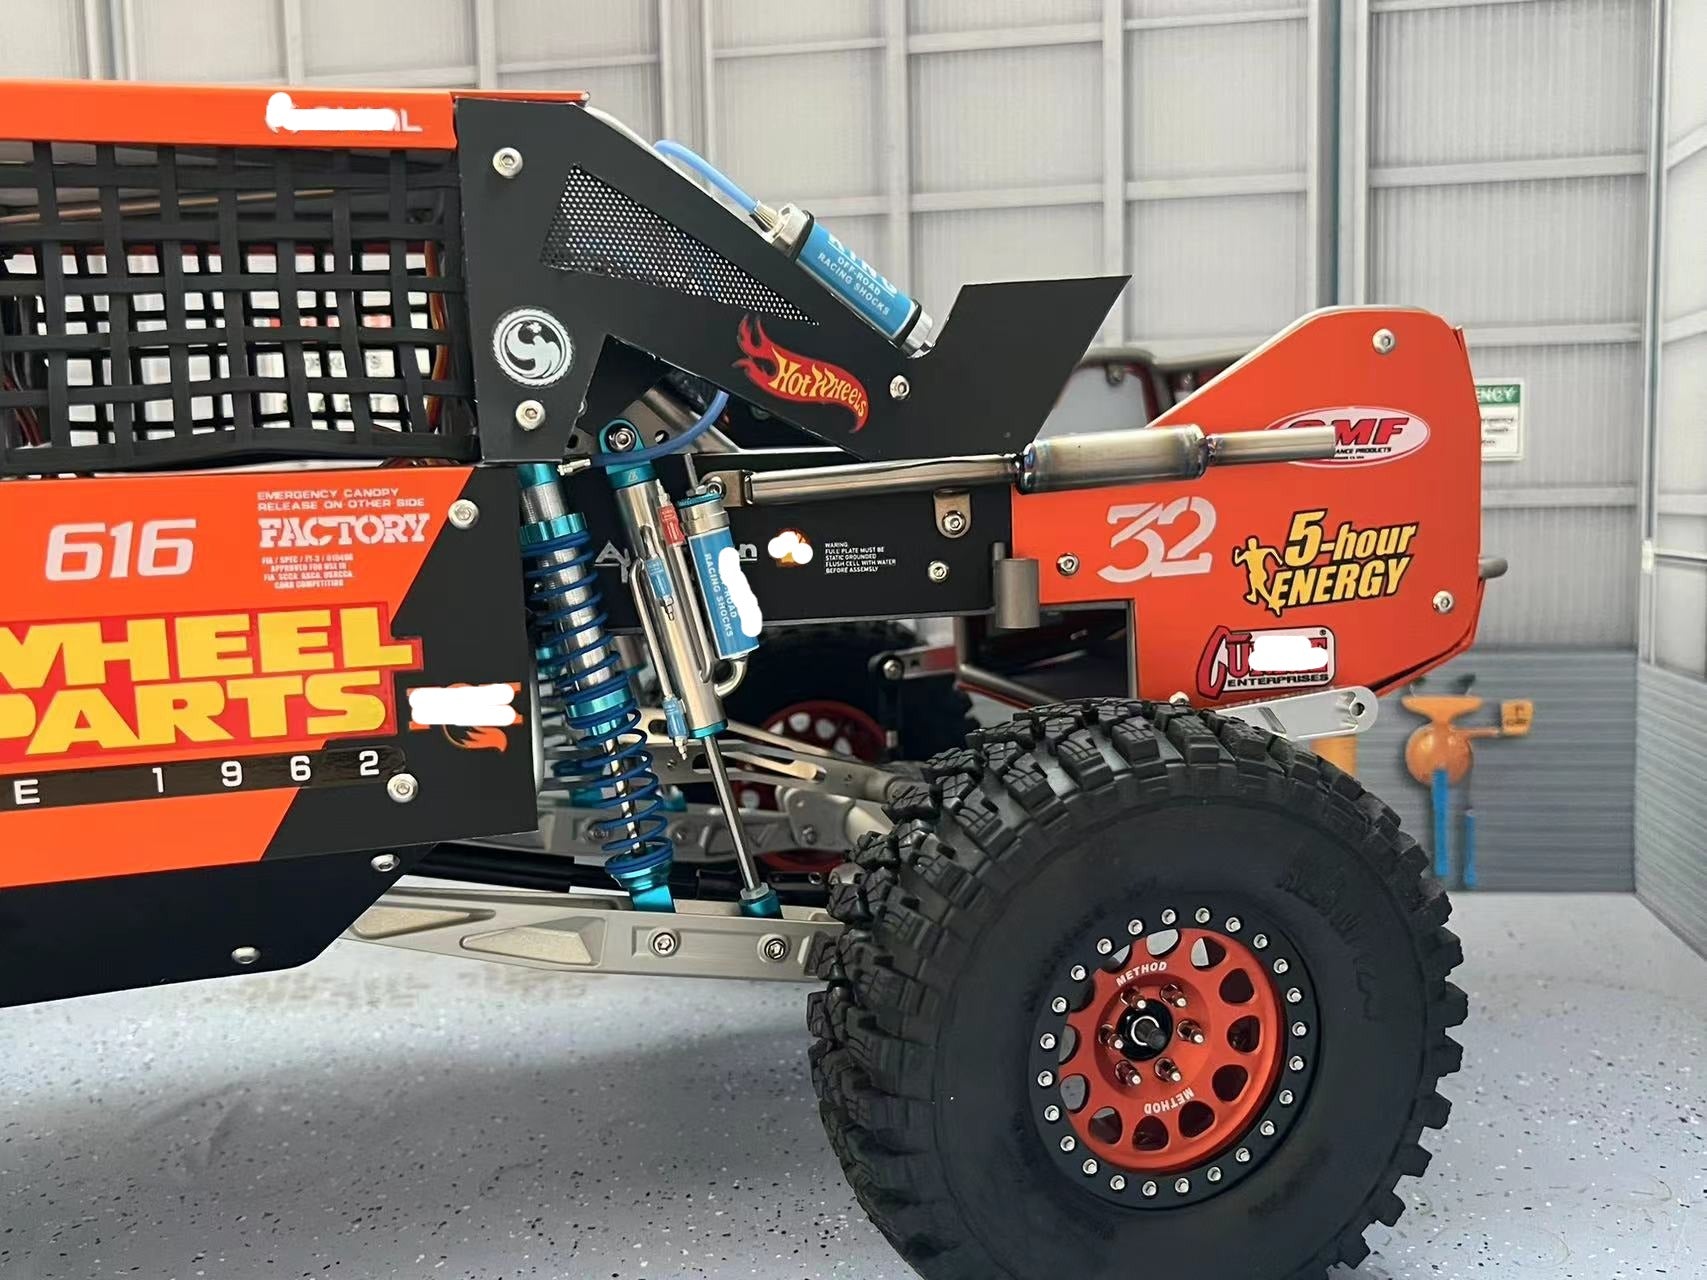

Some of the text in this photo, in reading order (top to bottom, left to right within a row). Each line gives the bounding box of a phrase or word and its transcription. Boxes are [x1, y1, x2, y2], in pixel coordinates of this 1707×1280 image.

[818, 253, 854, 284] RACING
[854, 283, 890, 316] SHOCKS
[838, 256, 881, 295] OFF-ROAD
[257, 488, 399, 500] EMERGENCY CANOPY
[257, 498, 424, 511] RELEASE ON OTHER SIDE
[45, 518, 197, 581] 616
[258, 513, 430, 548] FACTORY
[1097, 496, 1217, 583] 32
[1284, 509, 1418, 567] 5-hour
[705, 553, 734, 637] RACING SHOCKS
[1271, 556, 1410, 608] ENERGY
[1228, 674, 1329, 687] ENTERPRISES
[1115, 961, 1168, 987] METHOD
[1144, 1087, 1195, 1115] METHOD
